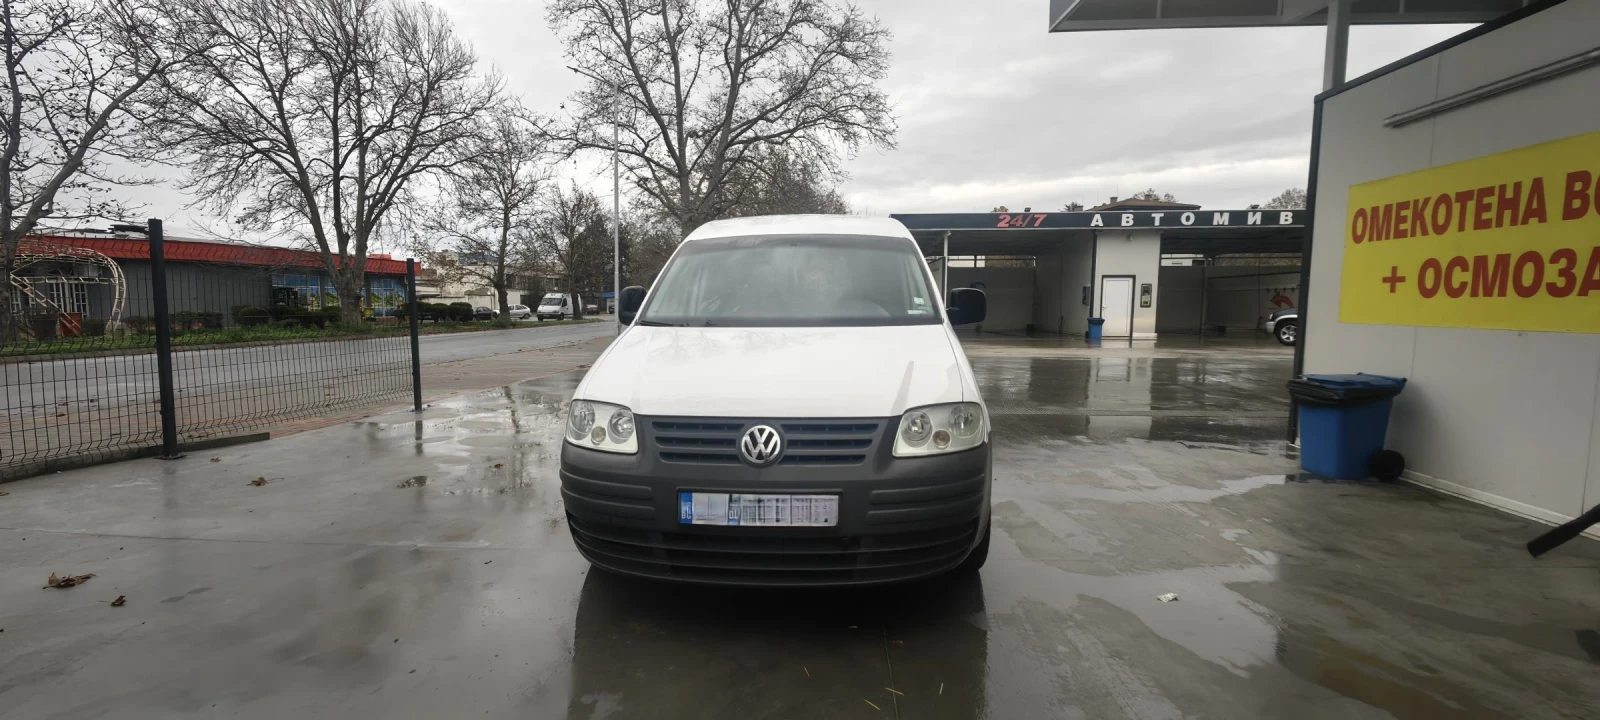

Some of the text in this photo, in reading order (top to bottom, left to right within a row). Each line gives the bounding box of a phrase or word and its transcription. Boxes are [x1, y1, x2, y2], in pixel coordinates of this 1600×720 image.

[997, 214, 1047, 227] 24/7
[1351, 170, 1600, 244] ОМЕКОТЕНА В
[1417, 246, 1600, 298] ОСМОЗА
